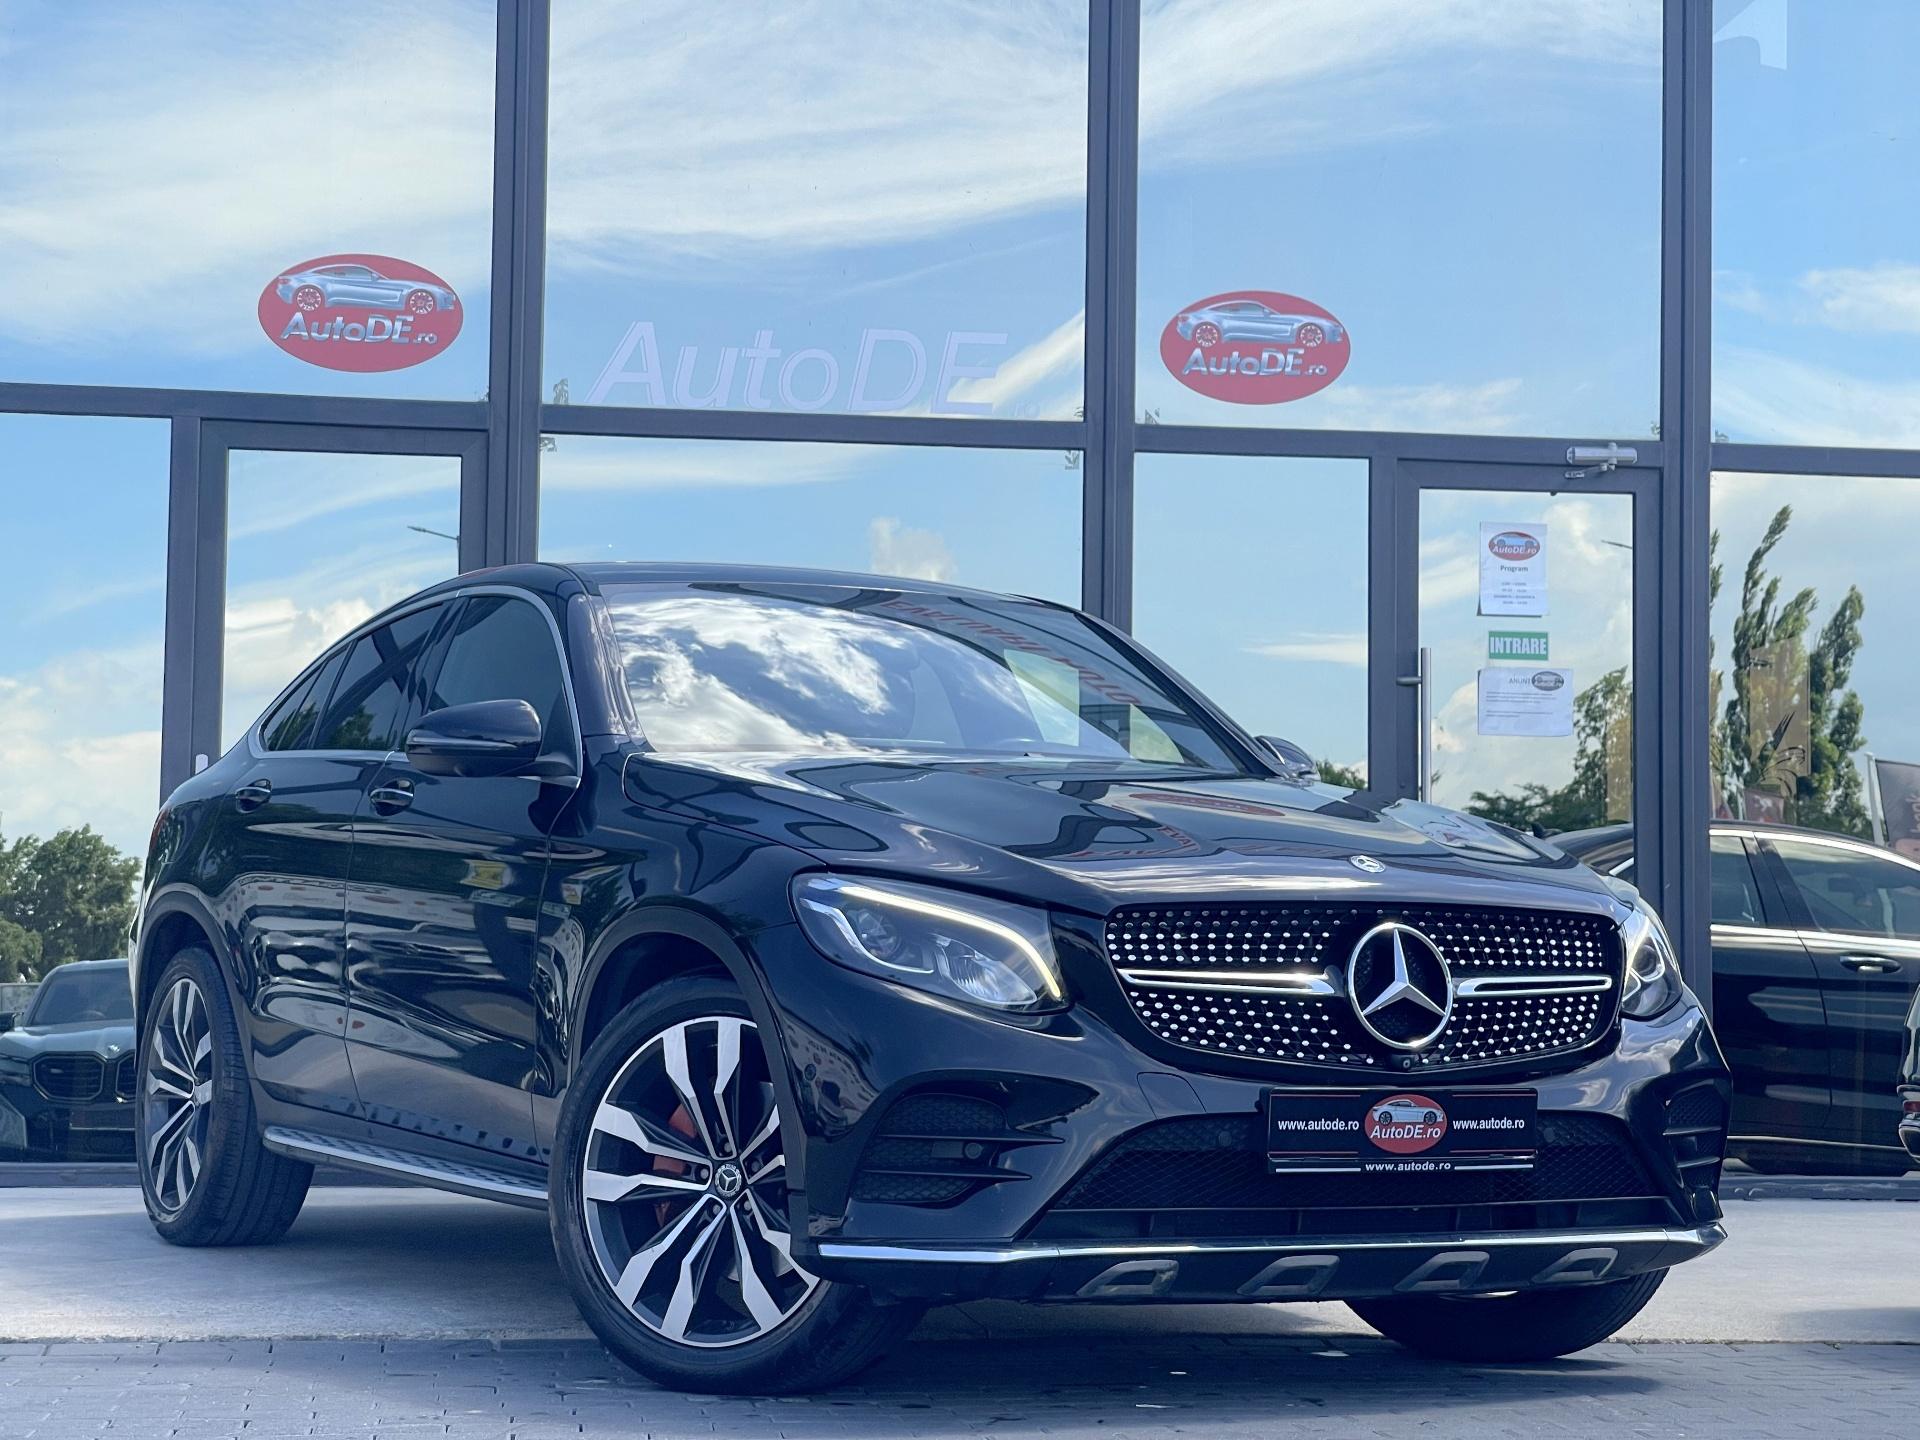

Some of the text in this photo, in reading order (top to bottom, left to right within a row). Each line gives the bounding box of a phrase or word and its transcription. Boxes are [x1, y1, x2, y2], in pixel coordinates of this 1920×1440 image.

[1500, 564, 1529, 573] Program
[1489, 636, 1547, 655] INTRARE
[1277, 1117, 1360, 1131] www.autode.ro
[1452, 1116, 1526, 1130] www.autode.ro
[1370, 1125, 1441, 1139] AutoDE.ro
[1365, 1160, 1452, 1172] www.autode.ro
